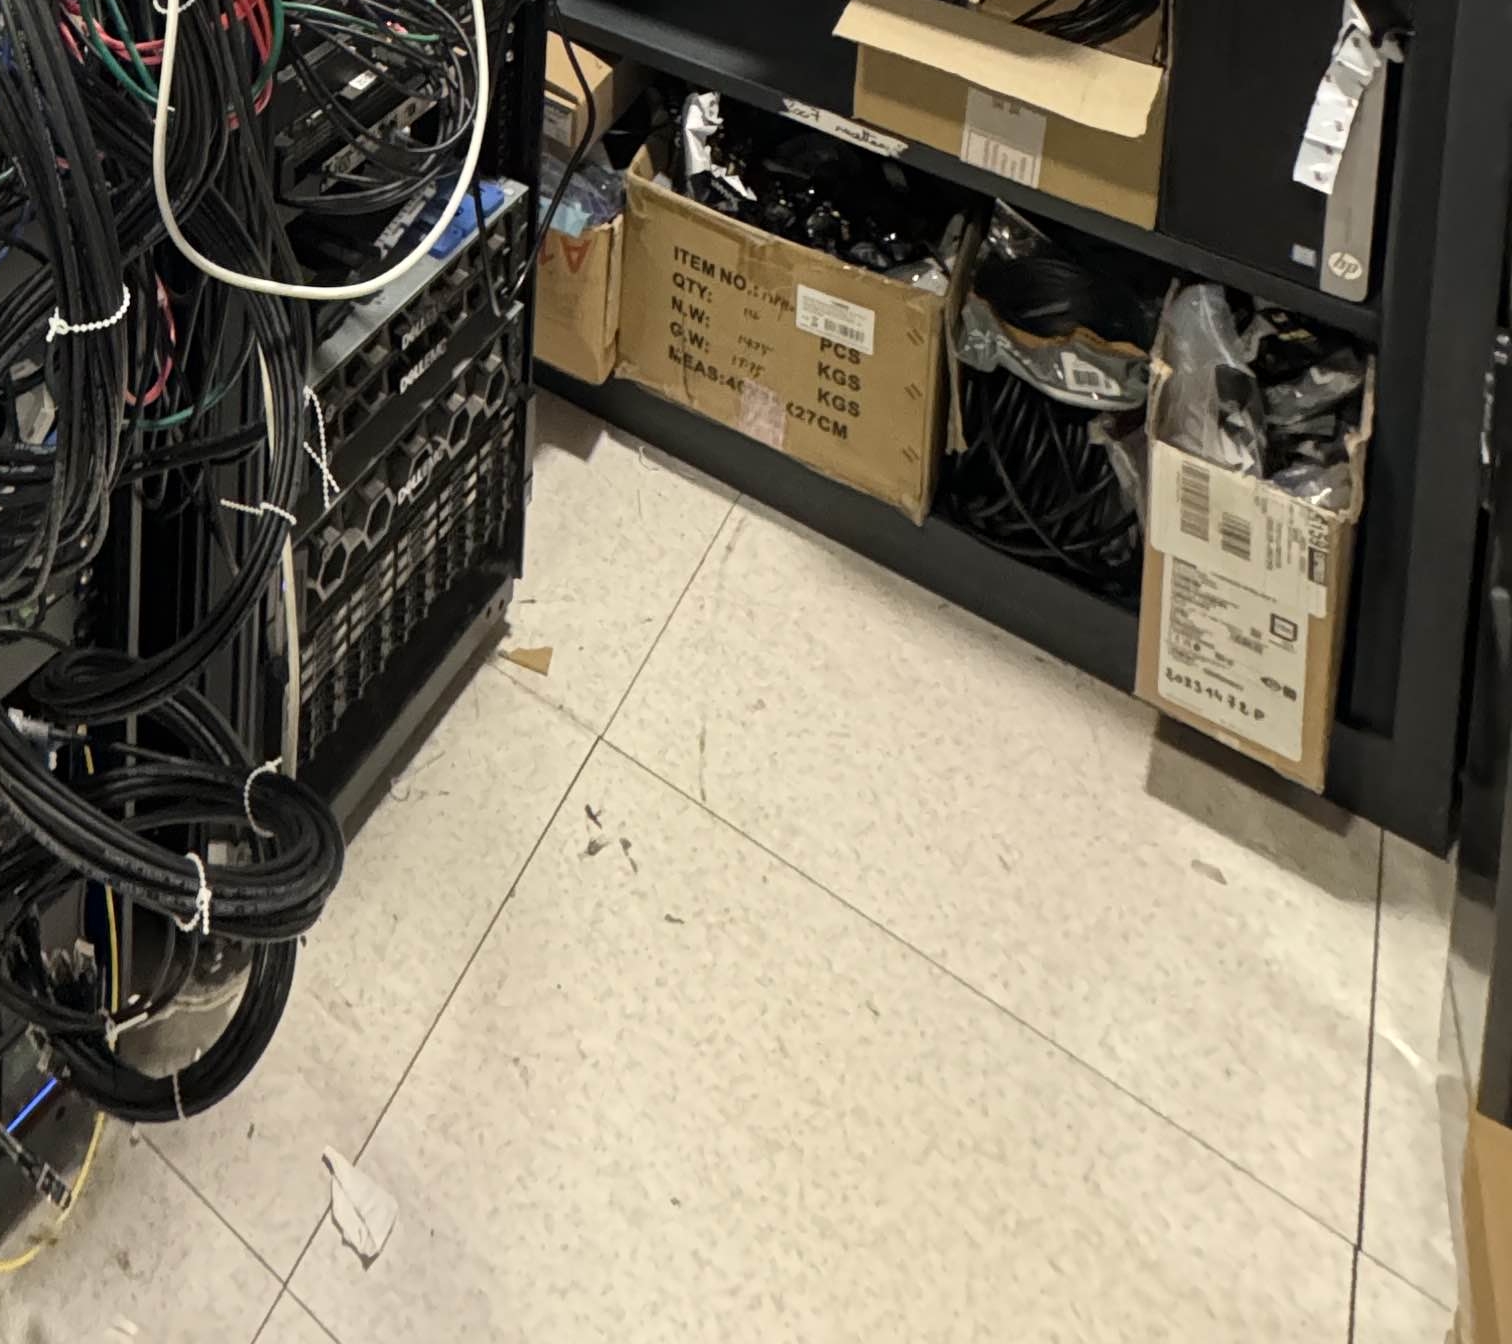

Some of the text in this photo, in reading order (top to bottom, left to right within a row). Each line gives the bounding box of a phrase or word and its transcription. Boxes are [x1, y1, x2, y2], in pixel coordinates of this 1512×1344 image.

[673, 246, 716, 279] ITEM
[672, 272, 713, 303] QTY:
[671, 296, 711, 328] N.W:
[669, 321, 710, 354] G.W:
[819, 337, 862, 365] PCS
[818, 361, 862, 392] KGS
[817, 387, 862, 419] KGS
